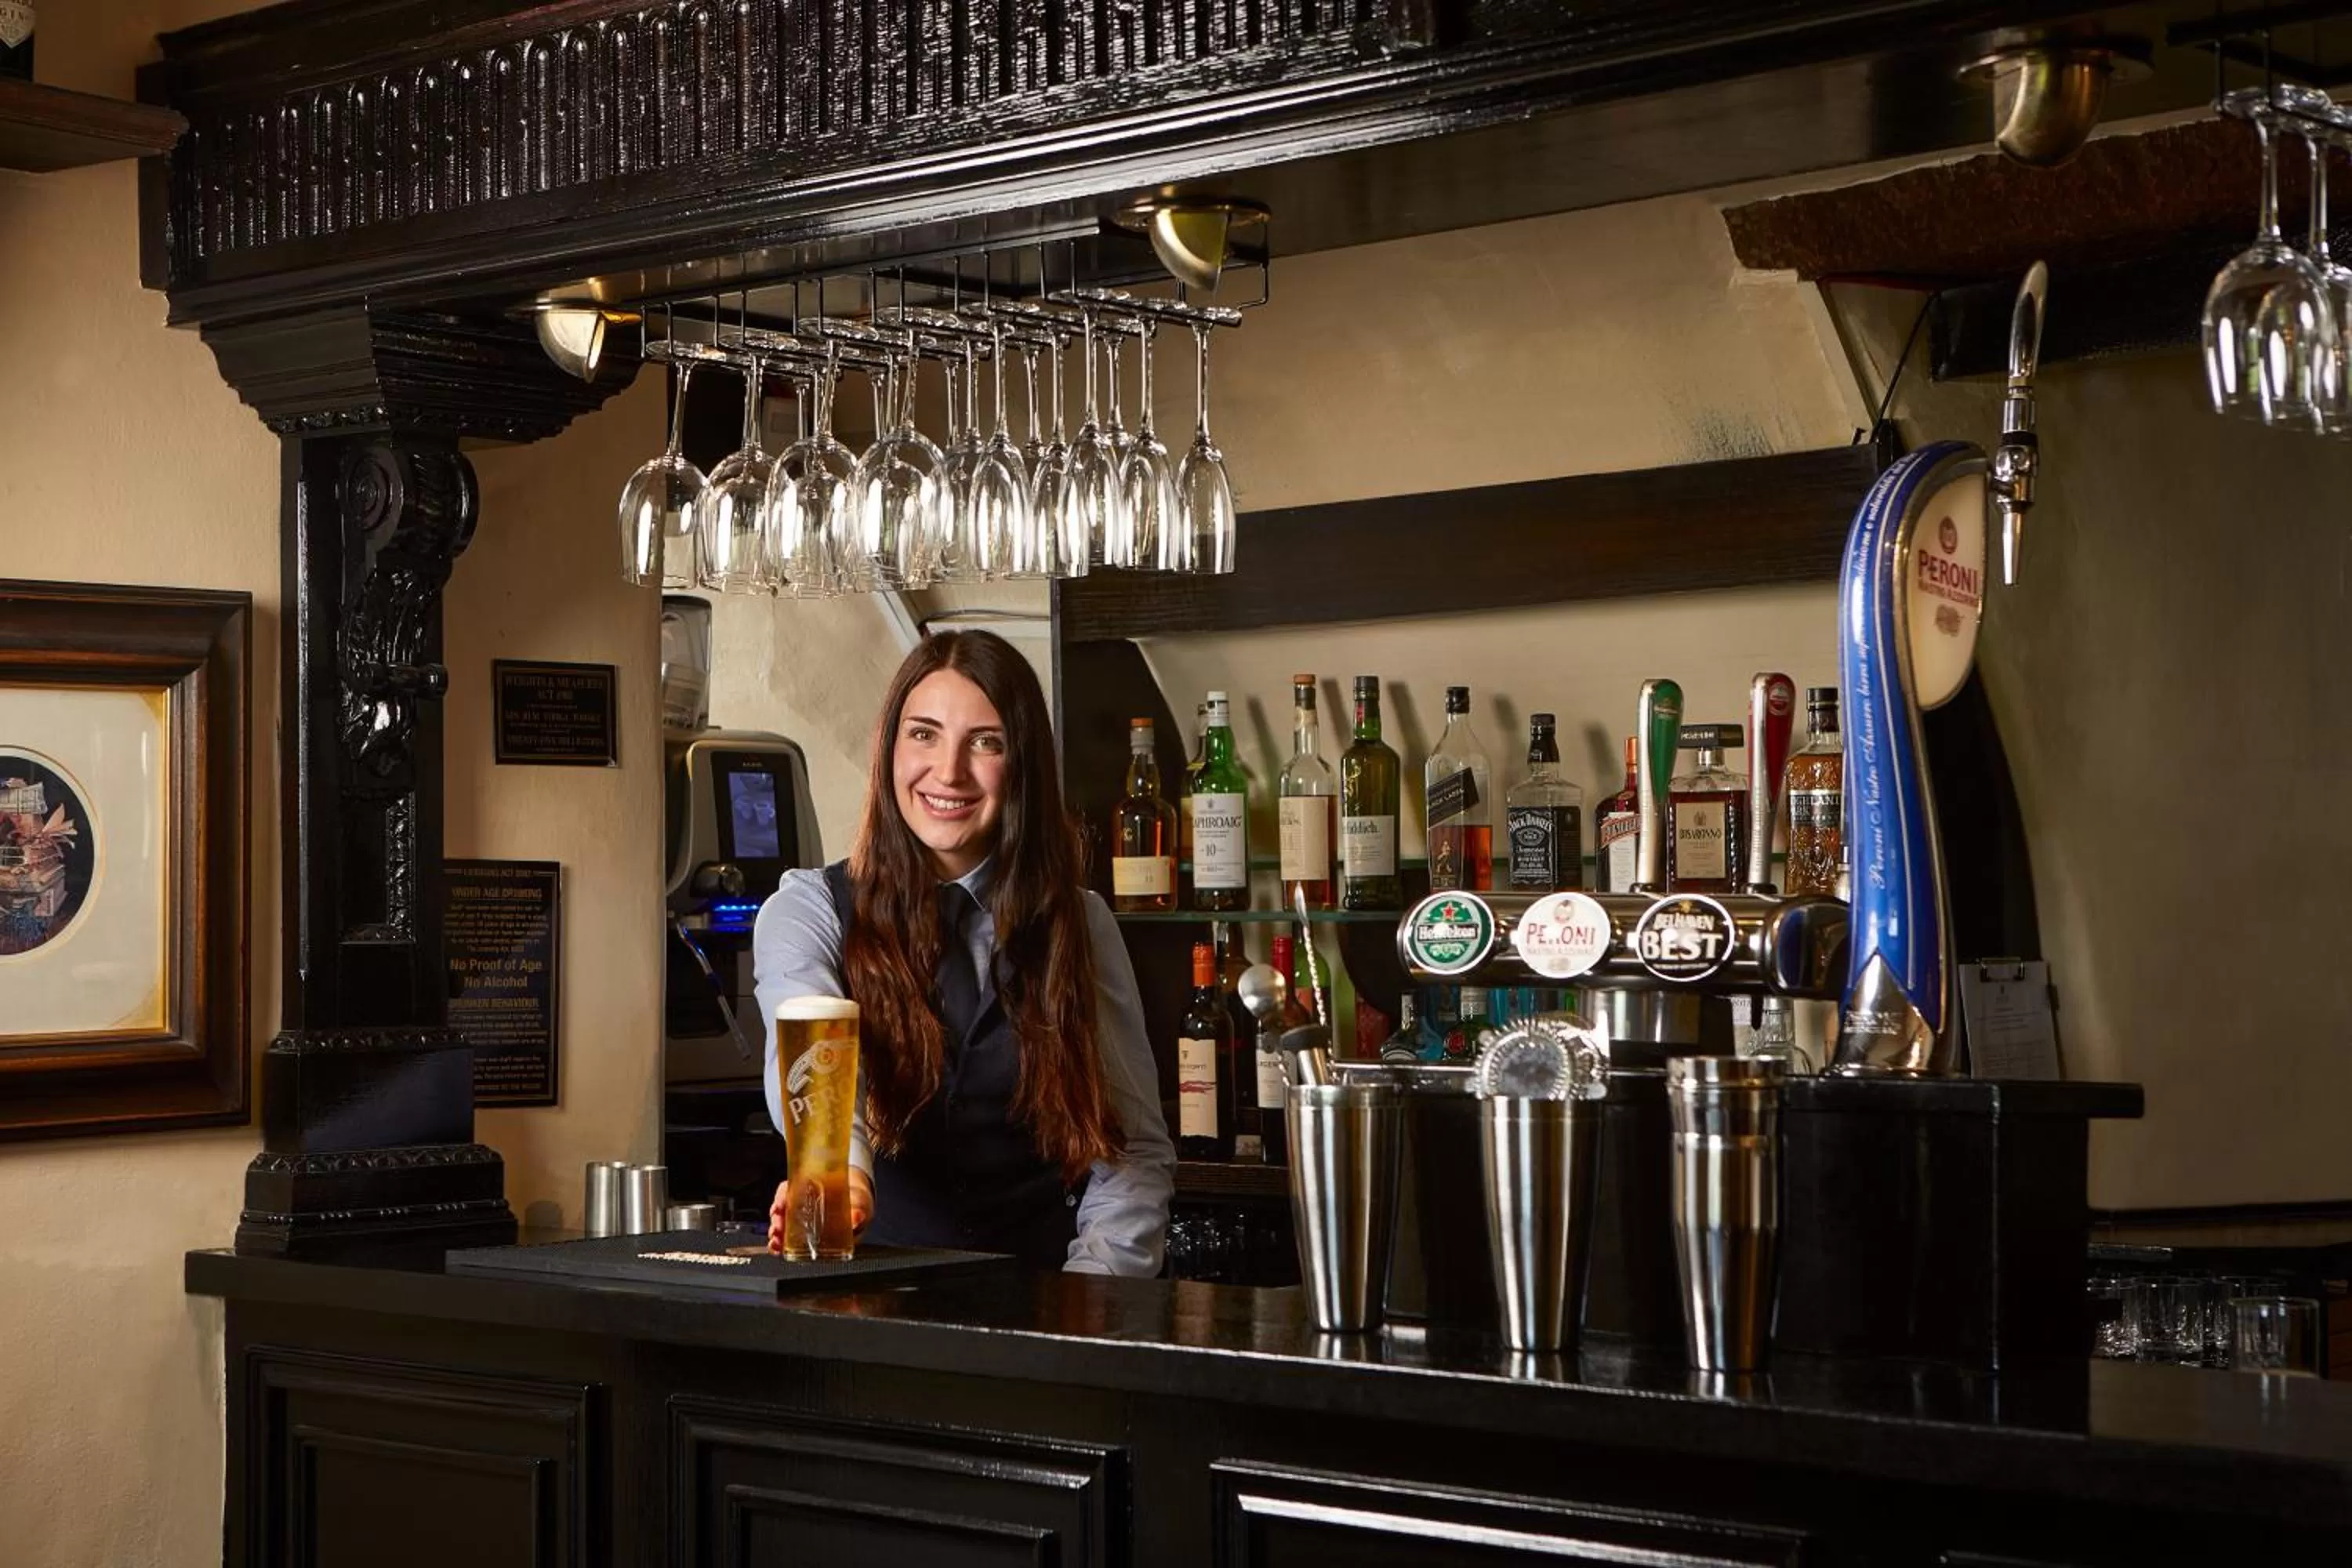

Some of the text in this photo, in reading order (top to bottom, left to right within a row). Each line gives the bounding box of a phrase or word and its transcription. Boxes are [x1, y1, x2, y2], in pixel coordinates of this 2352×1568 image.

[1918, 550, 1979, 594] PERONI
[1856, 663, 1871, 697] birra
[1859, 697, 1877, 764] Azzurro
[1863, 764, 1882, 826] Nastro
[1192, 816, 1242, 829] APHROAIG
[1342, 819, 1380, 834] fiddich.
[1679, 828, 1722, 840] DISARONNO
[1206, 843, 1216, 857] 10
[1868, 823, 1886, 890] Peroni
[1653, 912, 1715, 931] BELHAVEN
[1419, 924, 1475, 940] Heeken
[1526, 923, 1595, 946] PEONI
[1642, 930, 1723, 960] BEST
[450, 958, 543, 973] No Proof of Age
[464, 975, 528, 988] No Alcohol
